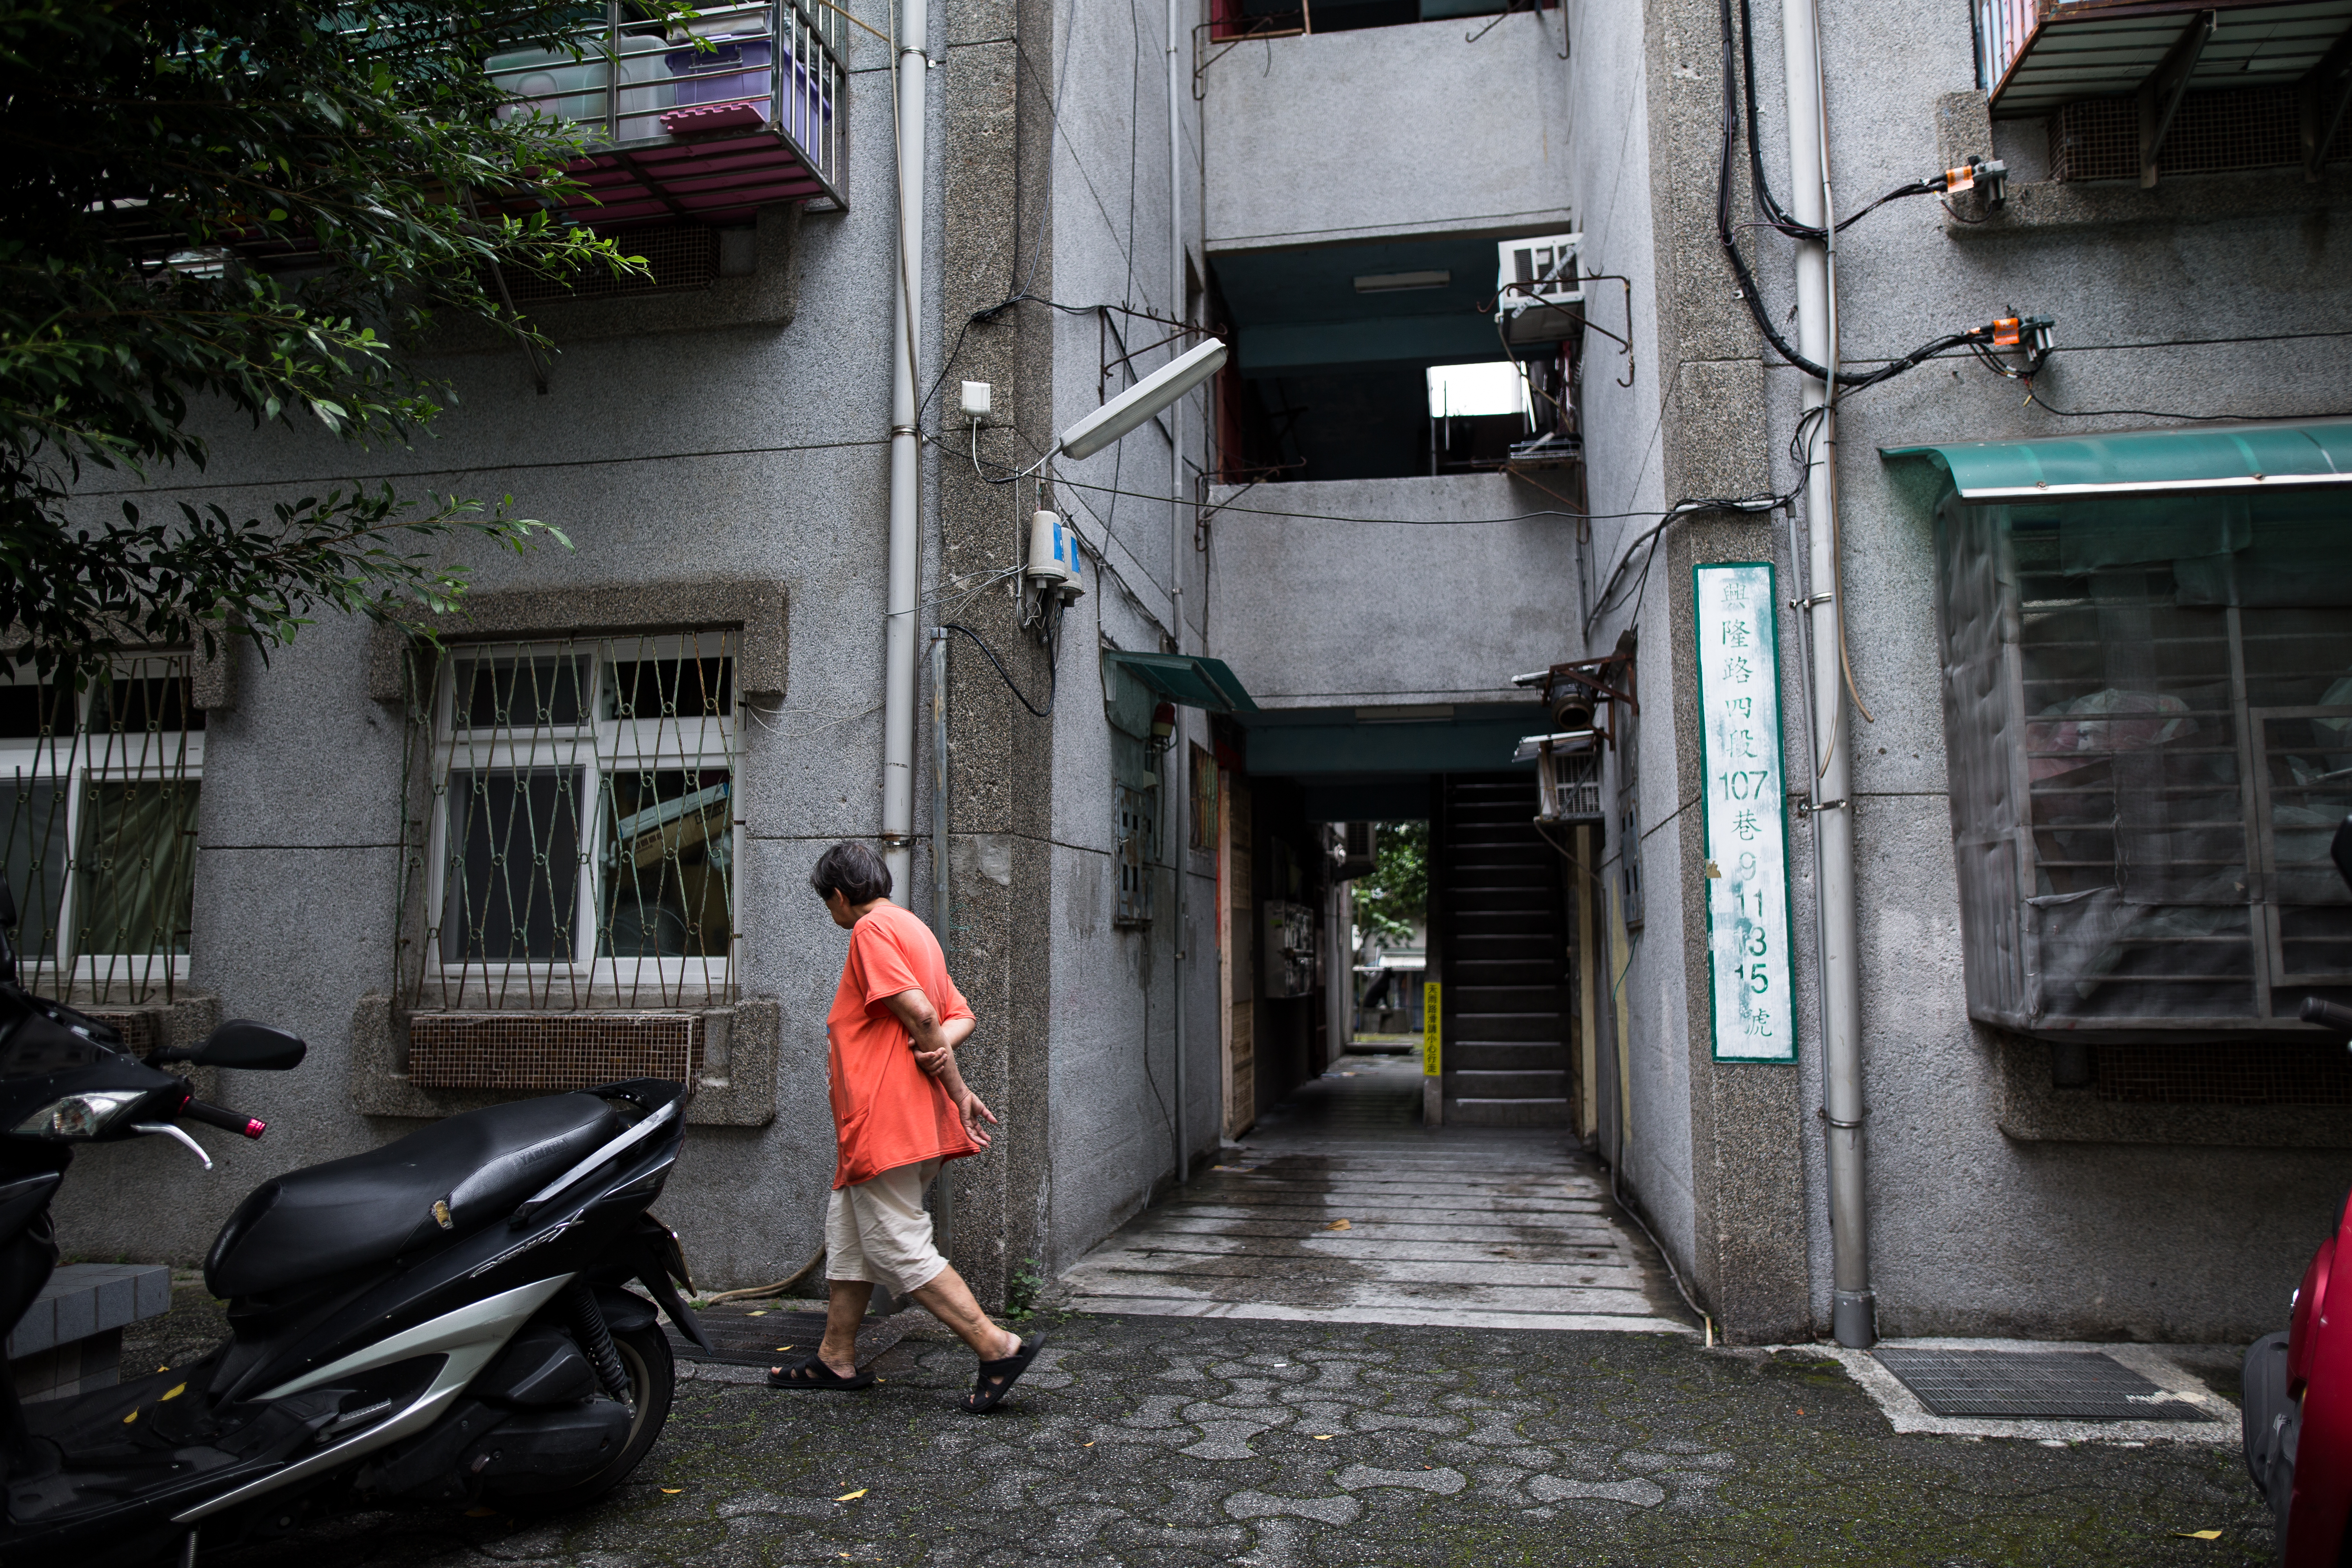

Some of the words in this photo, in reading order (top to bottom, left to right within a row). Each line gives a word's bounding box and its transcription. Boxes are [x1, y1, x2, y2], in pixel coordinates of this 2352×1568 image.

[1427, 984, 1437, 1073] 天雨路滑請小心行走
[515, 1138, 569, 1165] YAMAHA
